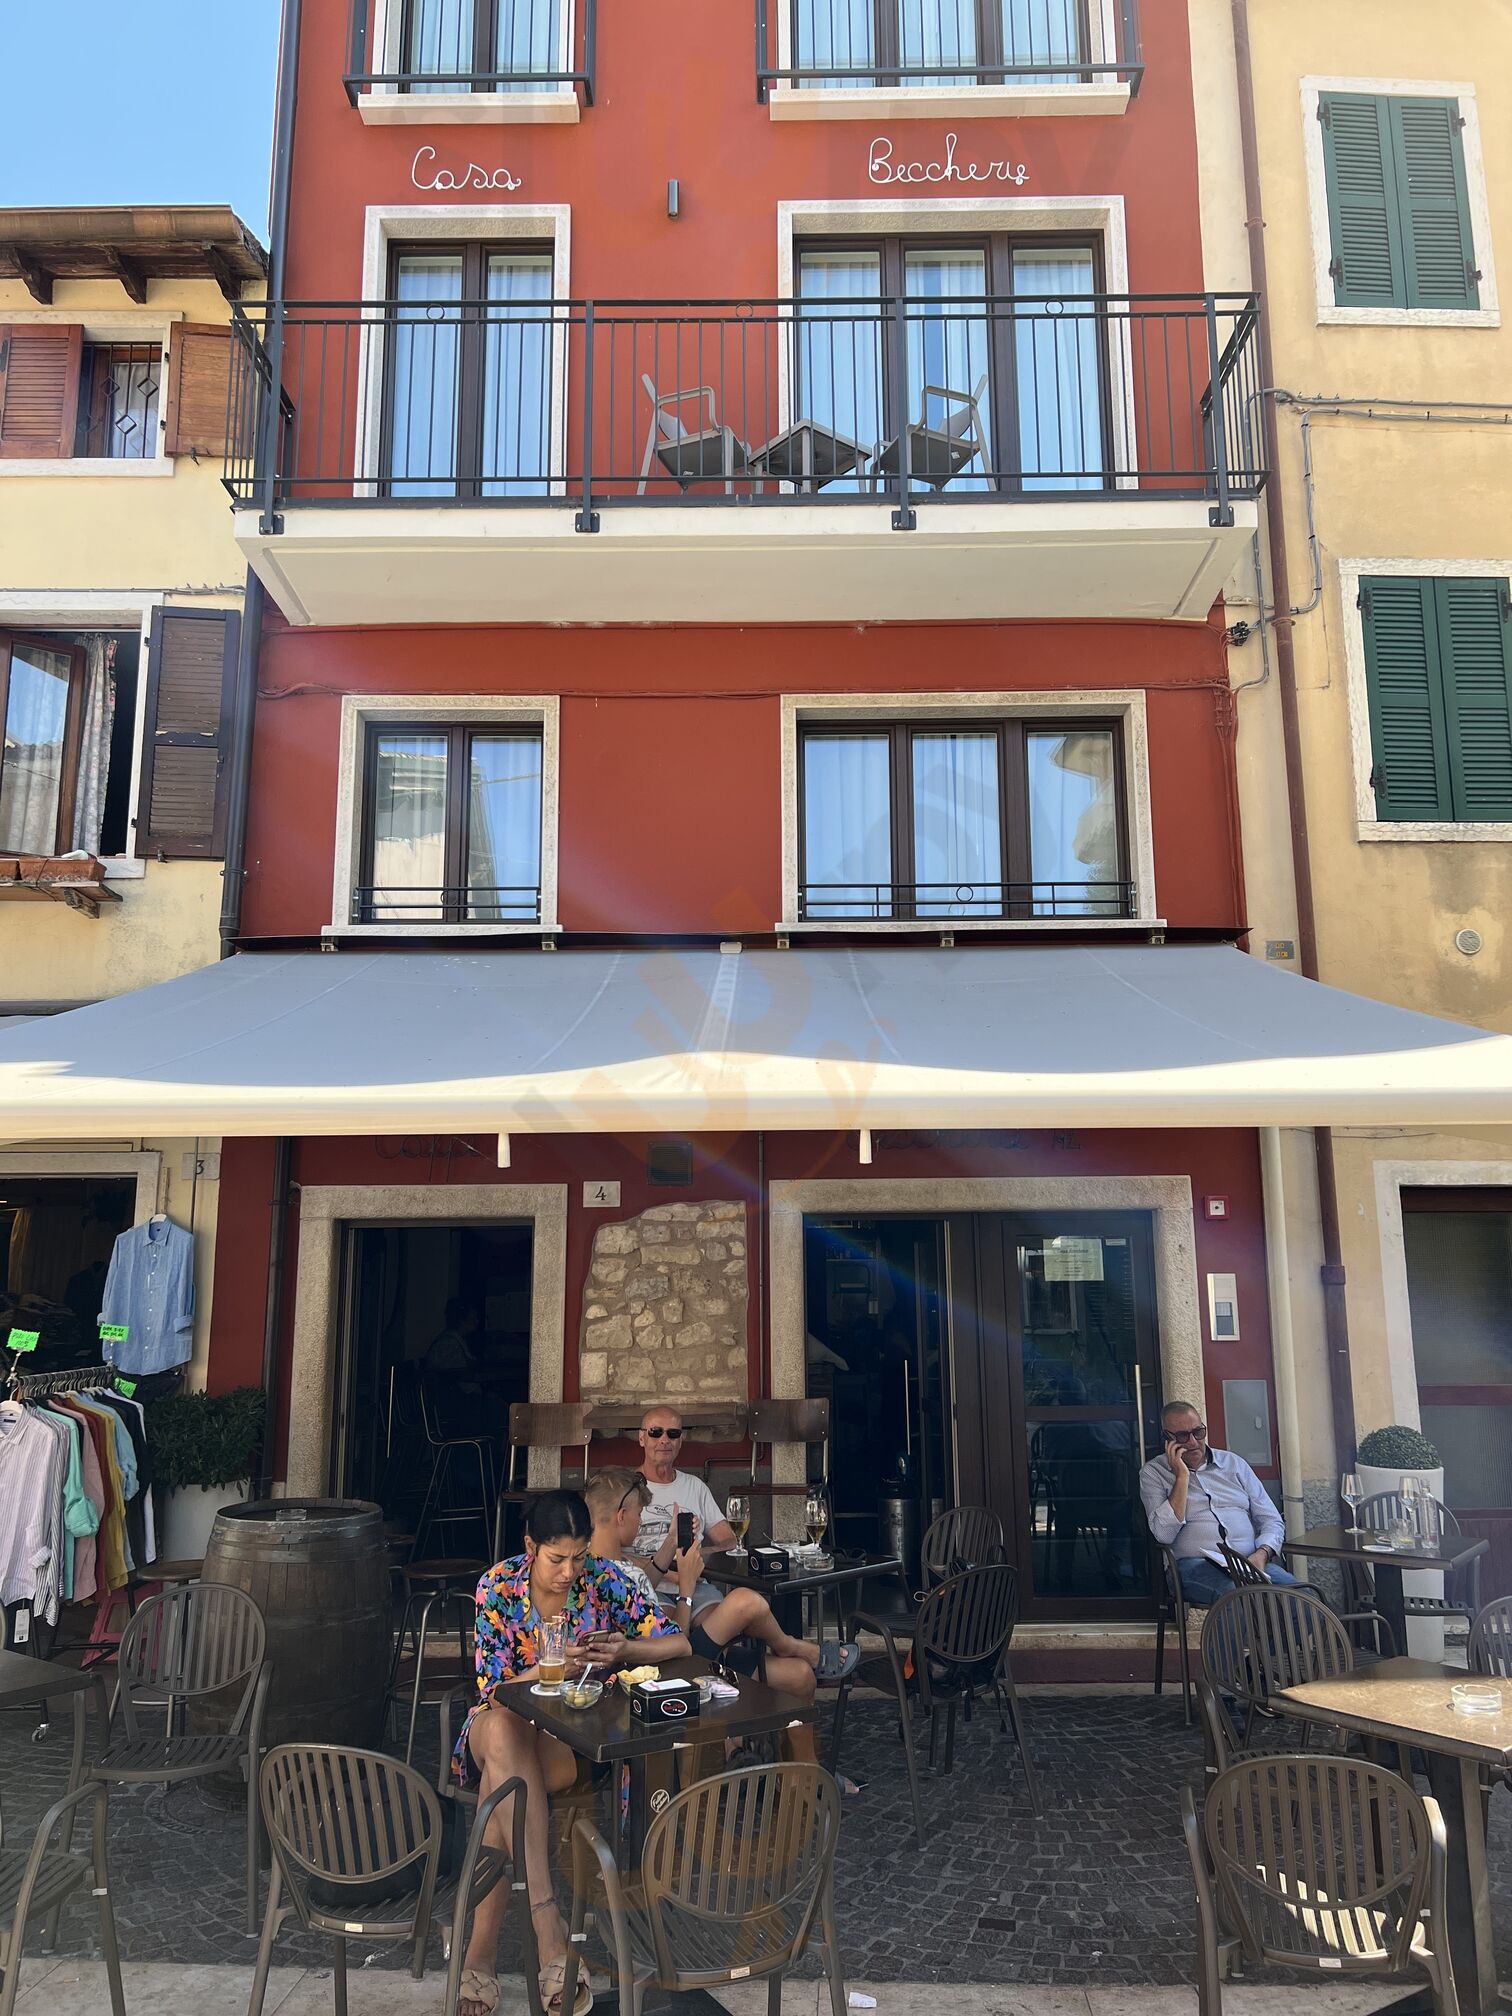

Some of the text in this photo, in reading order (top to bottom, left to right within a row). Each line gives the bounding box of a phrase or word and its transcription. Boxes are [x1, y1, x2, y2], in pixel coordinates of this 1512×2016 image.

[411, 132, 1030, 191] Casa Beccherie
[195, 1159, 205, 1175] 3
[594, 1185, 608, 1201] 4
